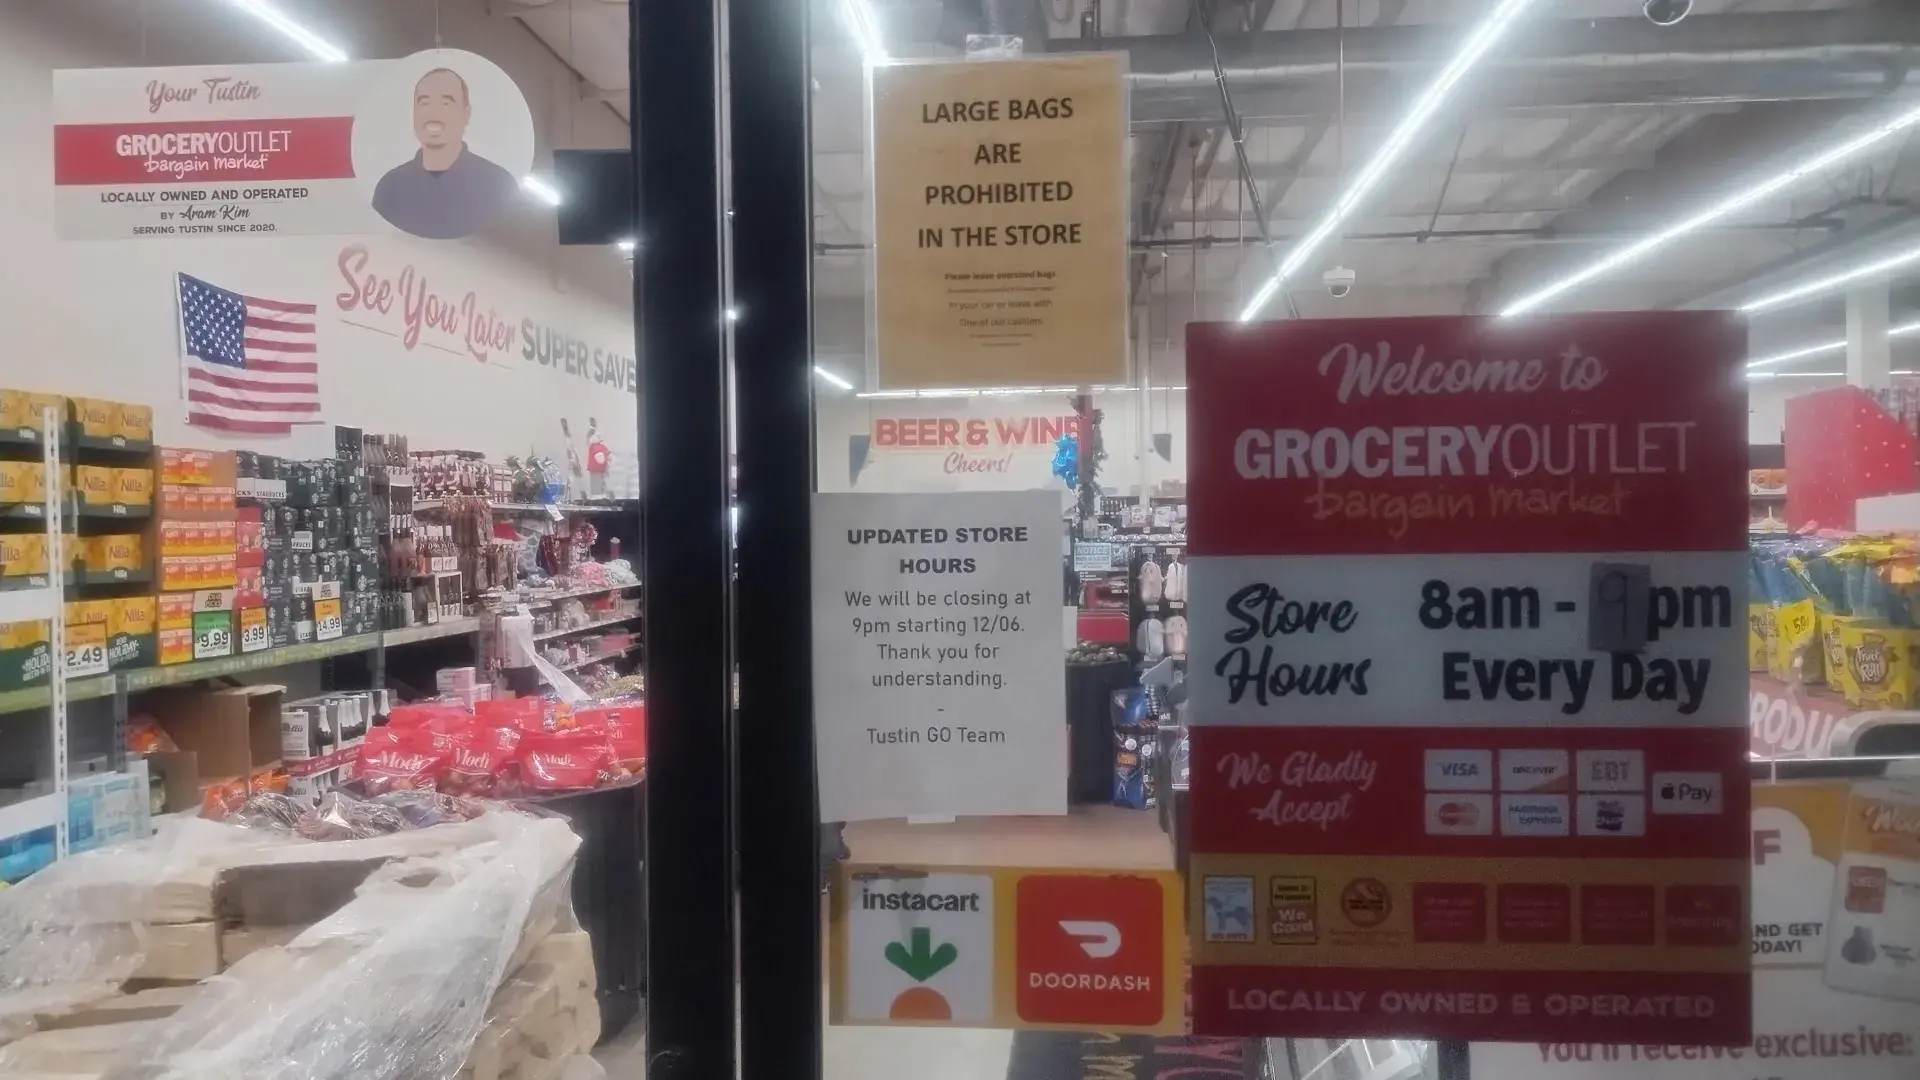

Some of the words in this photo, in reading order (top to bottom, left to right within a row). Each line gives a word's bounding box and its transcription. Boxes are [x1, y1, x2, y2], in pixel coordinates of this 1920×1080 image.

[146, 79, 198, 113] Your
[202, 77, 260, 102] Tustin
[922, 101, 1000, 123] LARGE
[1008, 98, 1073, 119] BAGS
[974, 143, 1022, 165] ARE
[144, 155, 209, 179] bargain
[212, 153, 268, 172] market
[100, 191, 155, 203] LOCALLY
[160, 189, 207, 202] OWNED
[212, 188, 239, 200] AND
[243, 187, 308, 199] OPERATED
[925, 181, 1073, 205] PROHIBITED
[160, 211, 175, 220] BY
[179, 206, 217, 222] Aram
[219, 203, 250, 221] Kim
[133, 225, 175, 235] SERVING
[178, 224, 214, 233] TUSTIN
[217, 223, 246, 233] SINCE
[918, 228, 943, 248] IN
[951, 227, 997, 247] THE
[1005, 223, 1082, 246] STORE
[336, 244, 393, 315] See
[399, 264, 459, 350] You
[461, 291, 516, 364] Later
[521, 318, 591, 379] SUPER
[1318, 341, 1547, 404] Welcome
[1556, 343, 1608, 392] to
[875, 418, 960, 446] BEER
[966, 418, 990, 446] &
[994, 415, 1080, 446] WINE
[942, 451, 1012, 474] Cheers!
[1304, 478, 1476, 537] bargain
[1488, 480, 1626, 518] market
[847, 529, 948, 544] UPDATED
[955, 527, 1028, 543] STORE
[900, 558, 976, 574] HOURS
[845, 591, 872, 606] We
[879, 591, 909, 606] will
[917, 591, 937, 606] be
[944, 590, 1008, 609] closing
[1015, 590, 1031, 605] at
[1418, 579, 1541, 630] 8am
[1224, 581, 1357, 645] Store
[852, 618, 890, 637] 9pm
[897, 616, 966, 636] starting
[973, 616, 1025, 634] 12/06.
[66, 646, 103, 667] 2.49
[876, 643, 931, 659] Thank
[937, 646, 968, 663] you
[975, 643, 1000, 659] for
[1857, 645, 1880, 663] Fruit
[872, 671, 1007, 689] understanding.
[1214, 645, 1373, 706] Hours
[1443, 652, 1595, 714] Every
[1611, 653, 1711, 714] Day
[866, 728, 920, 744] Tustin
[927, 727, 951, 743] GO
[957, 727, 1006, 743] Team
[379, 751, 424, 771] Modi
[454, 748, 490, 768] Modi
[543, 753, 572, 766] Modi
[1216, 752, 1273, 789] We
[1281, 750, 1378, 792] Gladly
[1440, 763, 1478, 776] VISA
[1678, 783, 1712, 804] Pay
[1249, 789, 1353, 831] Accept
[862, 888, 980, 913] instacart
[1272, 920, 1314, 934] Card
[1789, 923, 1823, 936] GET
[1029, 972, 1151, 991] DOORDASH
[1228, 989, 1367, 1012] LOCALLY
[1380, 991, 1498, 1014] OWNED
[1544, 994, 1715, 1018] OPERATED
